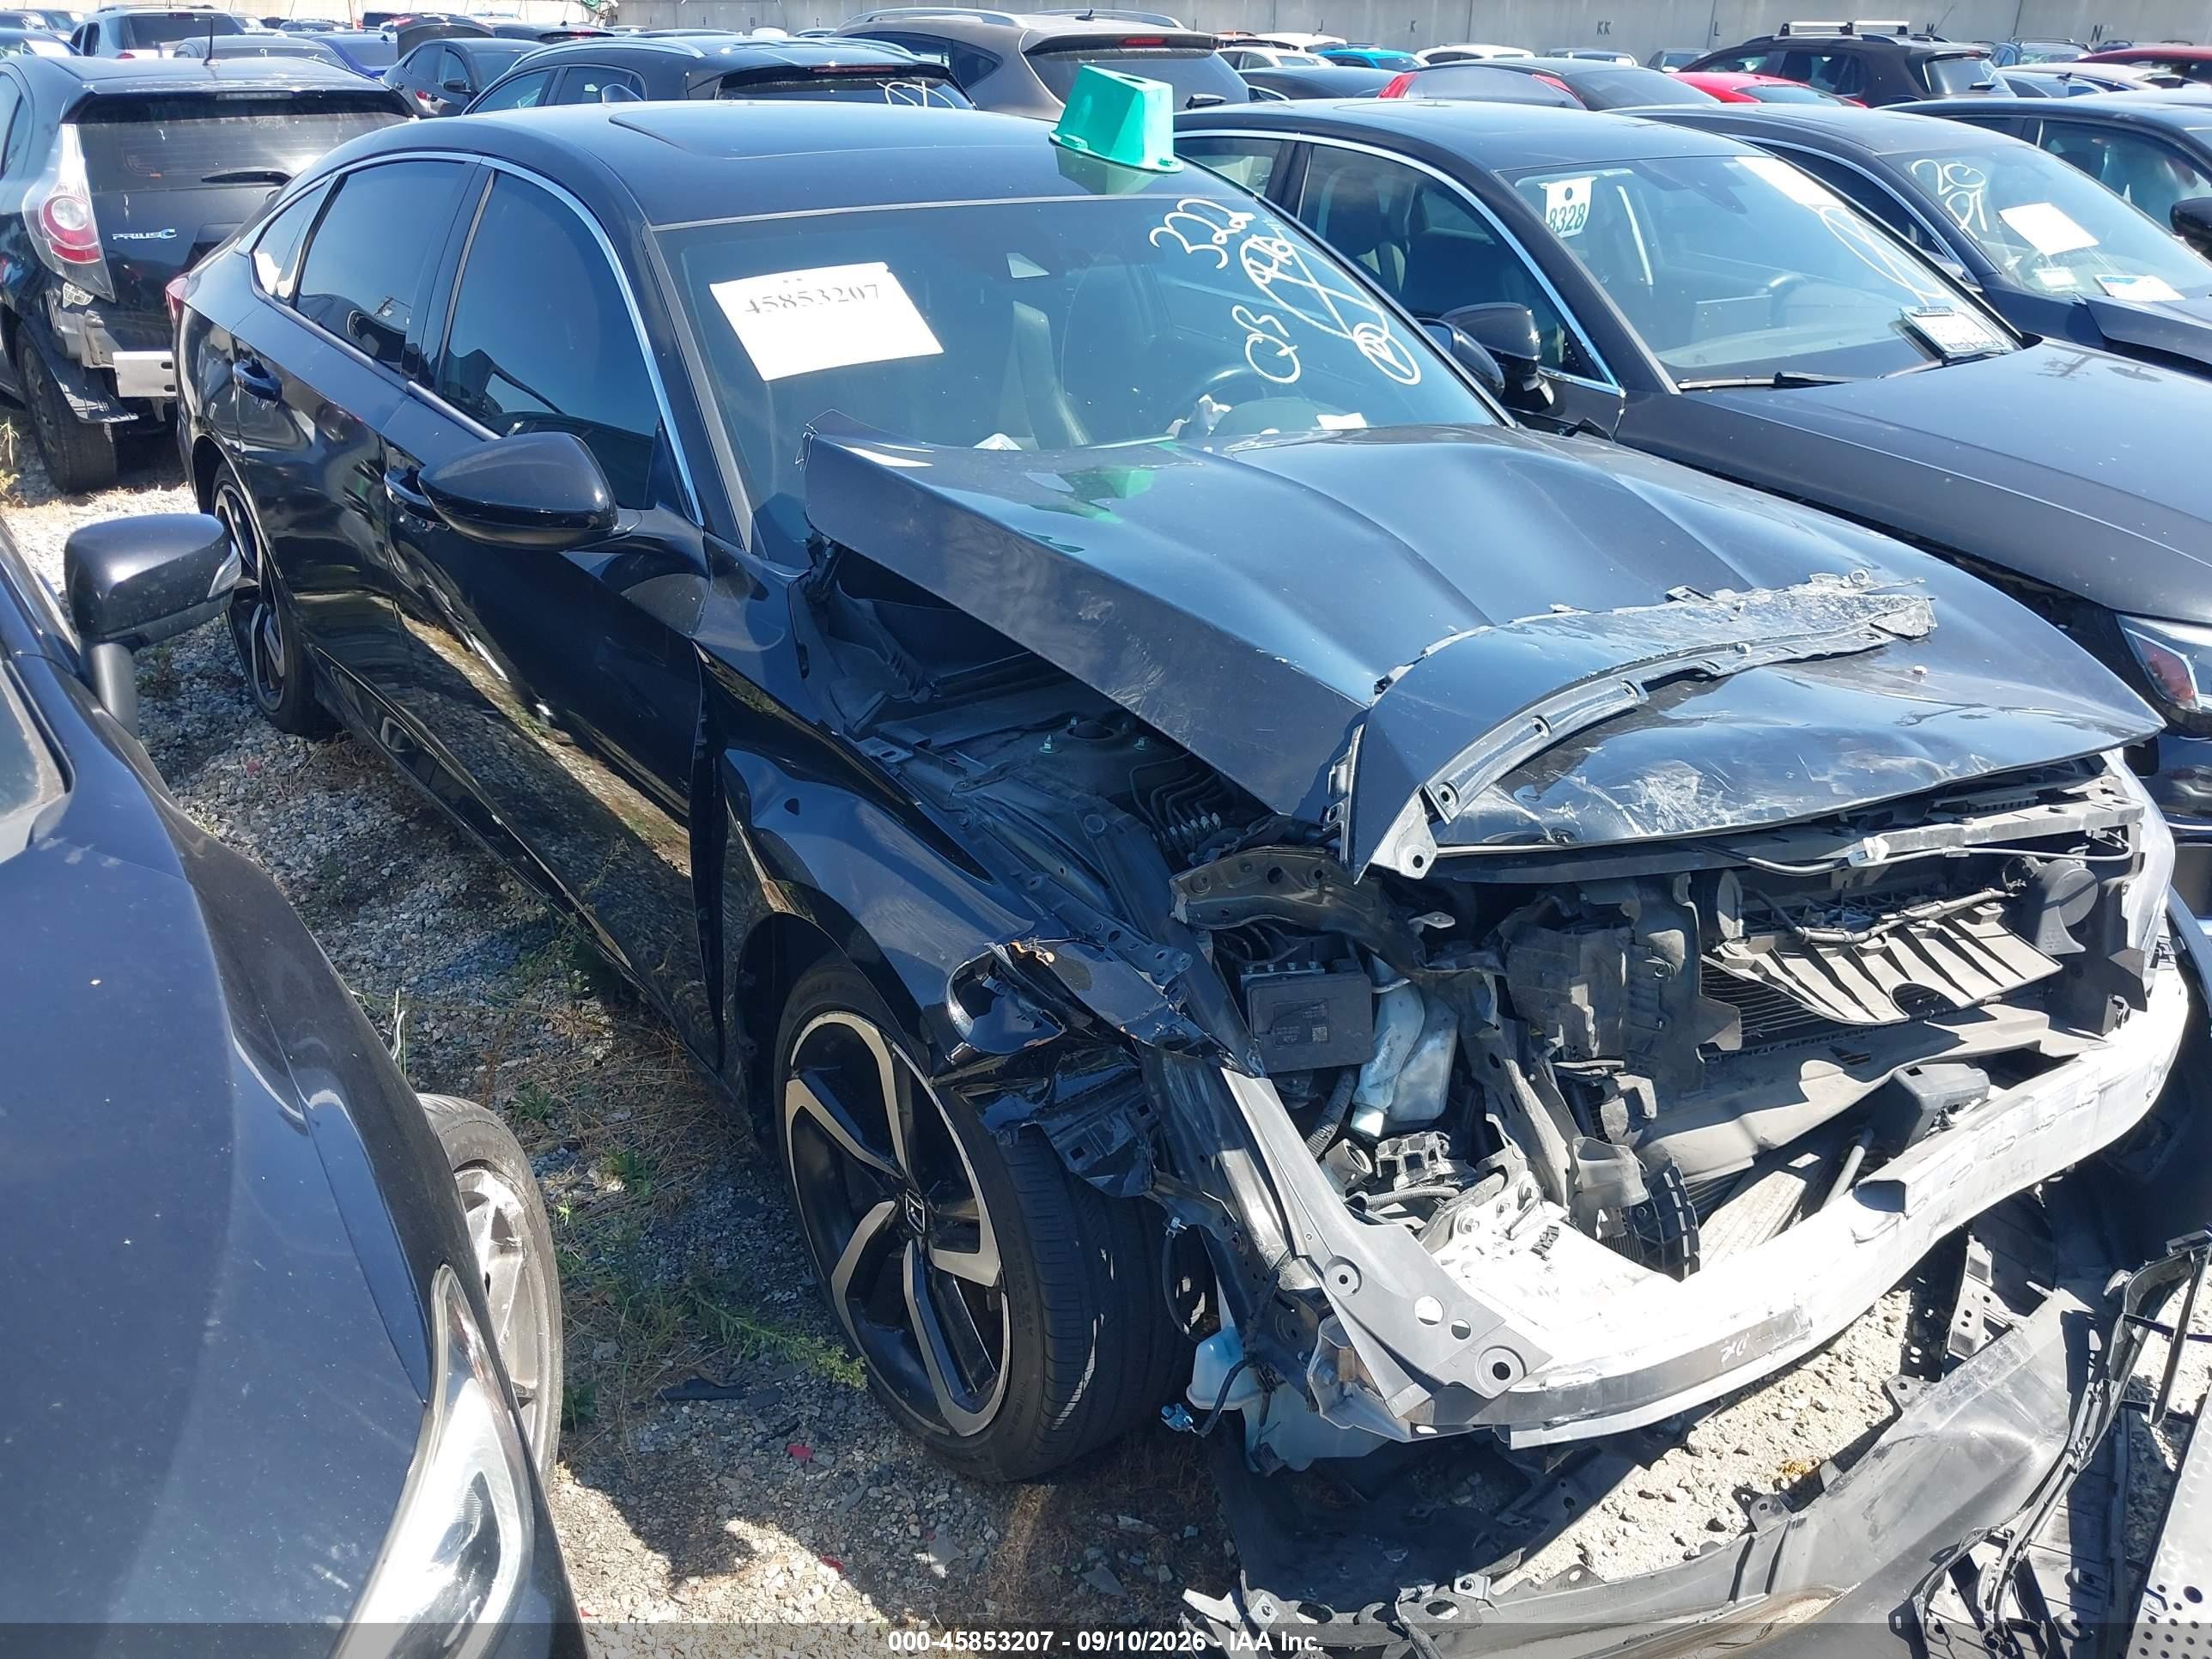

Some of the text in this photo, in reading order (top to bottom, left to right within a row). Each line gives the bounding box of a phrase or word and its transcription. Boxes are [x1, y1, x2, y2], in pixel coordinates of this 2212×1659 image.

[1317, 19, 1323, 32] J
[1409, 20, 1417, 33] K
[1596, 20, 1611, 35] KK
[1714, 21, 1720, 36] L
[2090, 25, 2103, 42] N
[1548, 202, 1586, 234] 8328
